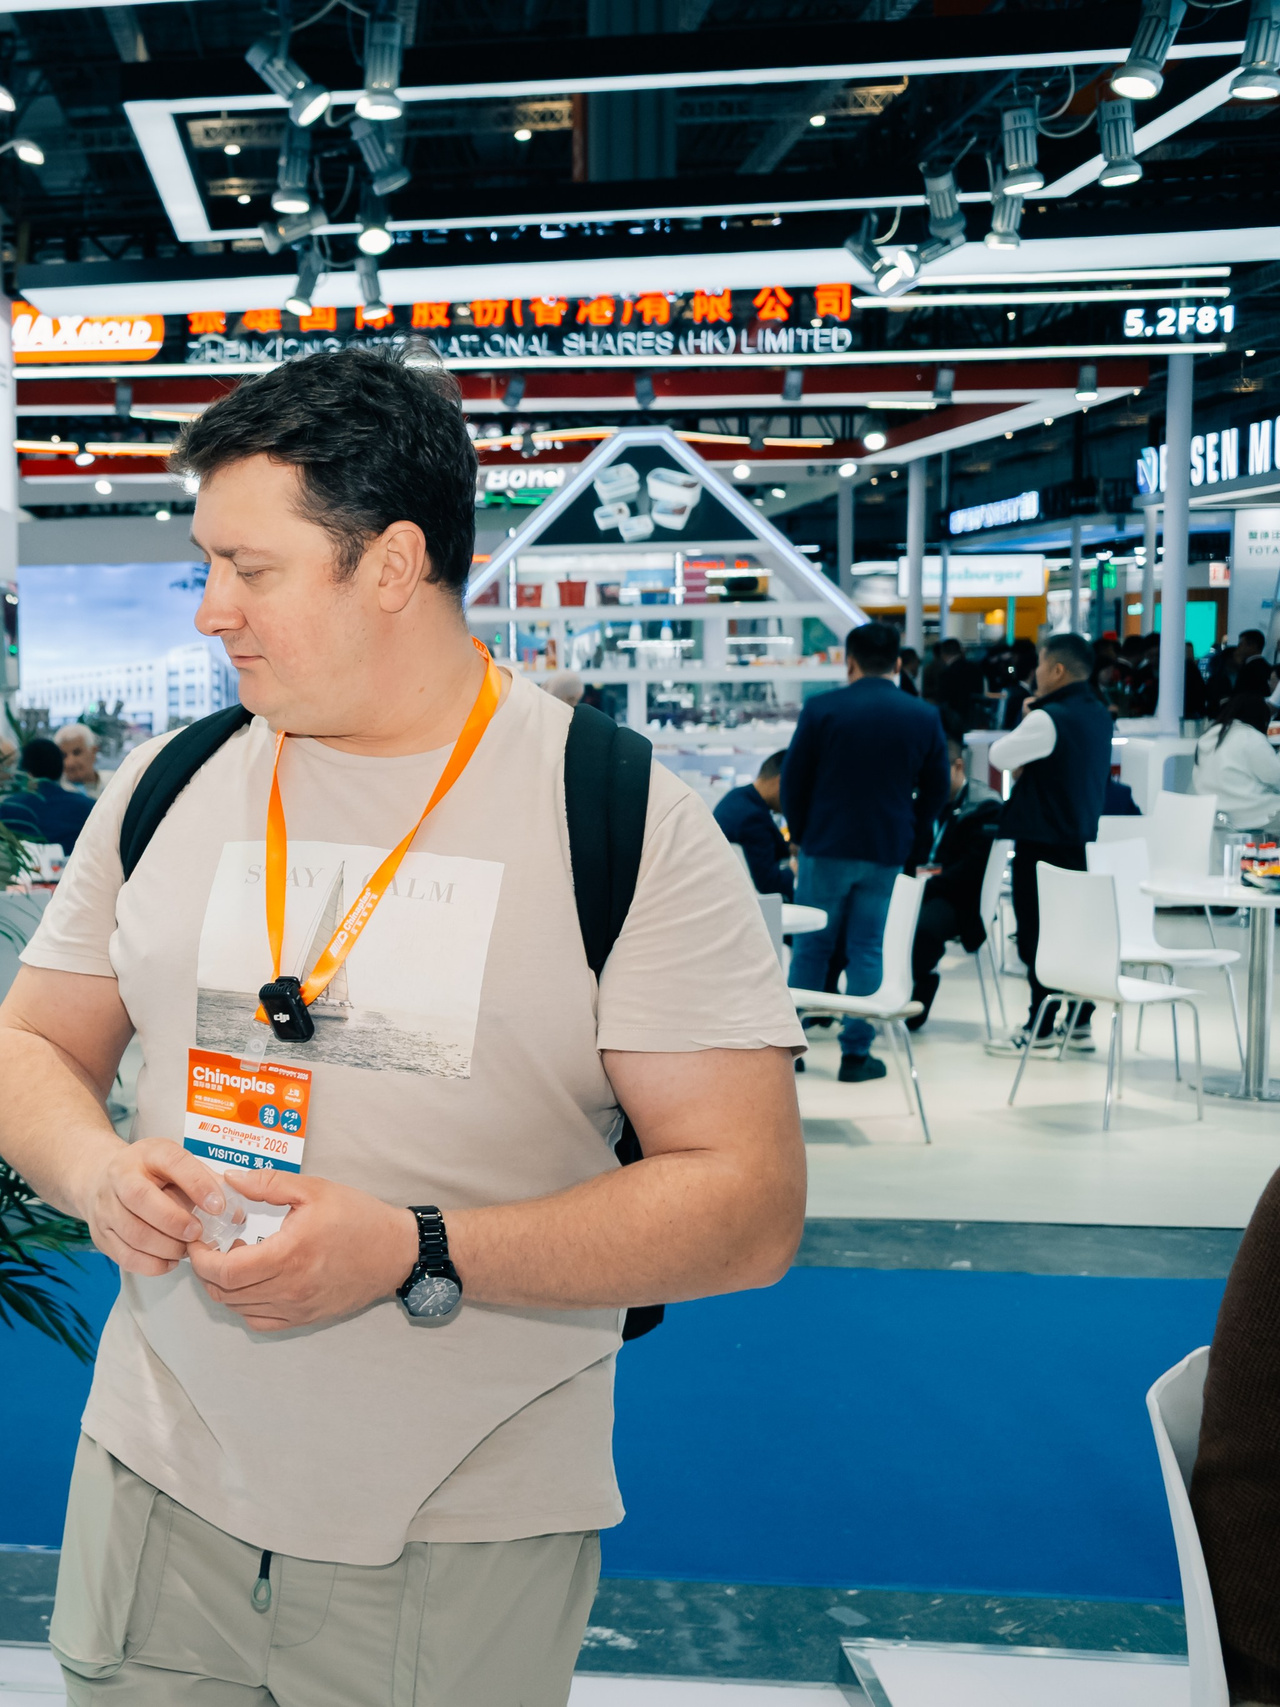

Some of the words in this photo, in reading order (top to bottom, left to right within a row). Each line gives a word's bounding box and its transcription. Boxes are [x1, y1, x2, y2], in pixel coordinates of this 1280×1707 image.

[1123, 304, 1236, 338] 5.2F81
[562, 331, 676, 357] SHARES
[678, 325, 736, 356] (HK)
[740, 326, 853, 354] LIMITED
[244, 864, 324, 889] SAY
[192, 1066, 276, 1095] Chinaplas
[264, 1107, 275, 1117] 20
[207, 1146, 250, 1166] VISITOR
[263, 1136, 289, 1155] 2026
